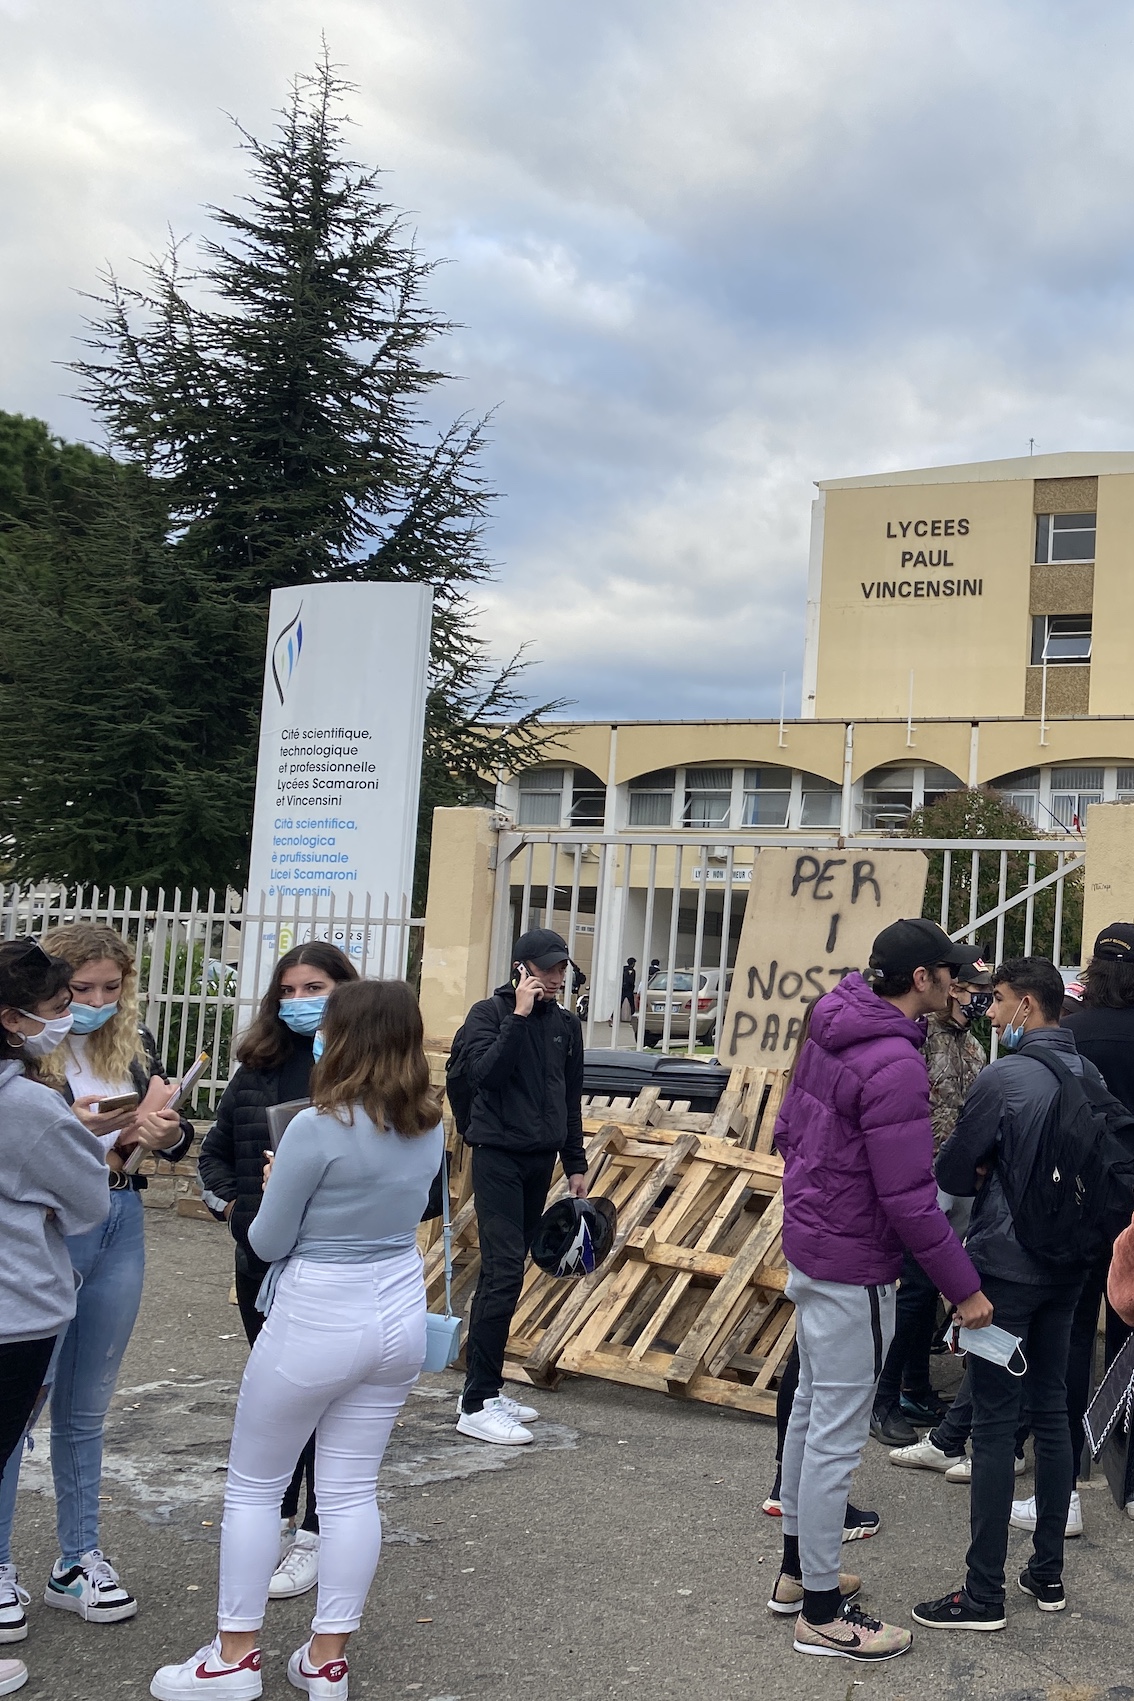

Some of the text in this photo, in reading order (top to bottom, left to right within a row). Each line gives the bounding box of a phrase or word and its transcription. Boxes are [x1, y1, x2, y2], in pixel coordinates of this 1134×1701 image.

[886, 518, 970, 538] LYCEES
[901, 549, 954, 568] PAUL
[861, 579, 983, 599] VINCENSINI
[281, 728, 372, 741] Cité scientifique,
[280, 744, 358, 758] technologique
[278, 761, 376, 775] et professionnelle
[277, 777, 379, 792] Lycées Scamaroni
[276, 794, 342, 806] et Vincensini
[274, 817, 358, 830] Cità scientifica,
[273, 835, 336, 848] tecnologica
[271, 851, 349, 864] è prufissiunale
[270, 868, 358, 880] Licei Scamaroni
[791, 855, 881, 907] PER
